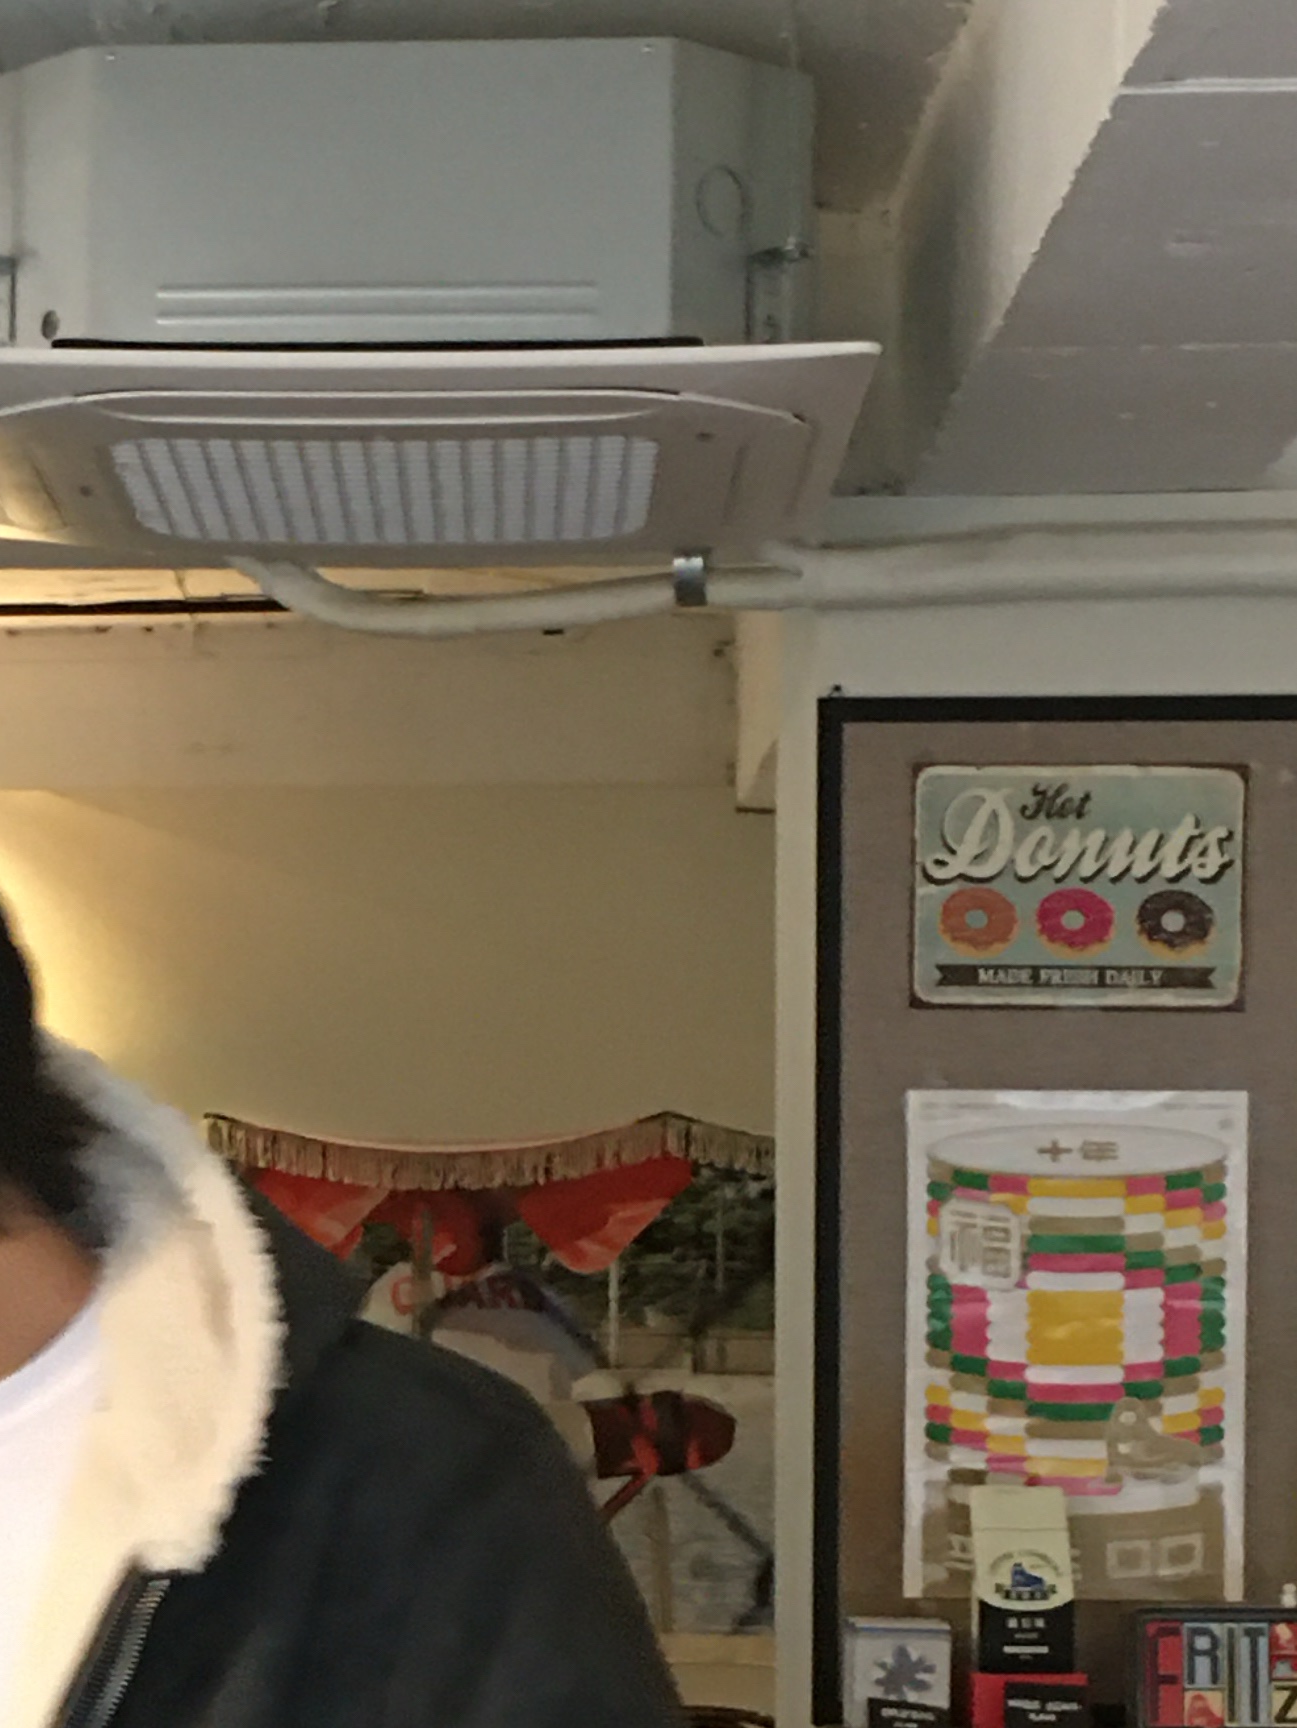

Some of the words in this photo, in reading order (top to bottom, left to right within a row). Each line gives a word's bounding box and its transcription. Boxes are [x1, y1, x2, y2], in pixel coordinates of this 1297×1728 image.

[1020, 783, 1091, 820] Hot
[922, 787, 1234, 885] Donuts
[978, 967, 1033, 984] MADE
[1106, 968, 1164, 986] DAILY
[1148, 1625, 1297, 1724] FRITZ
